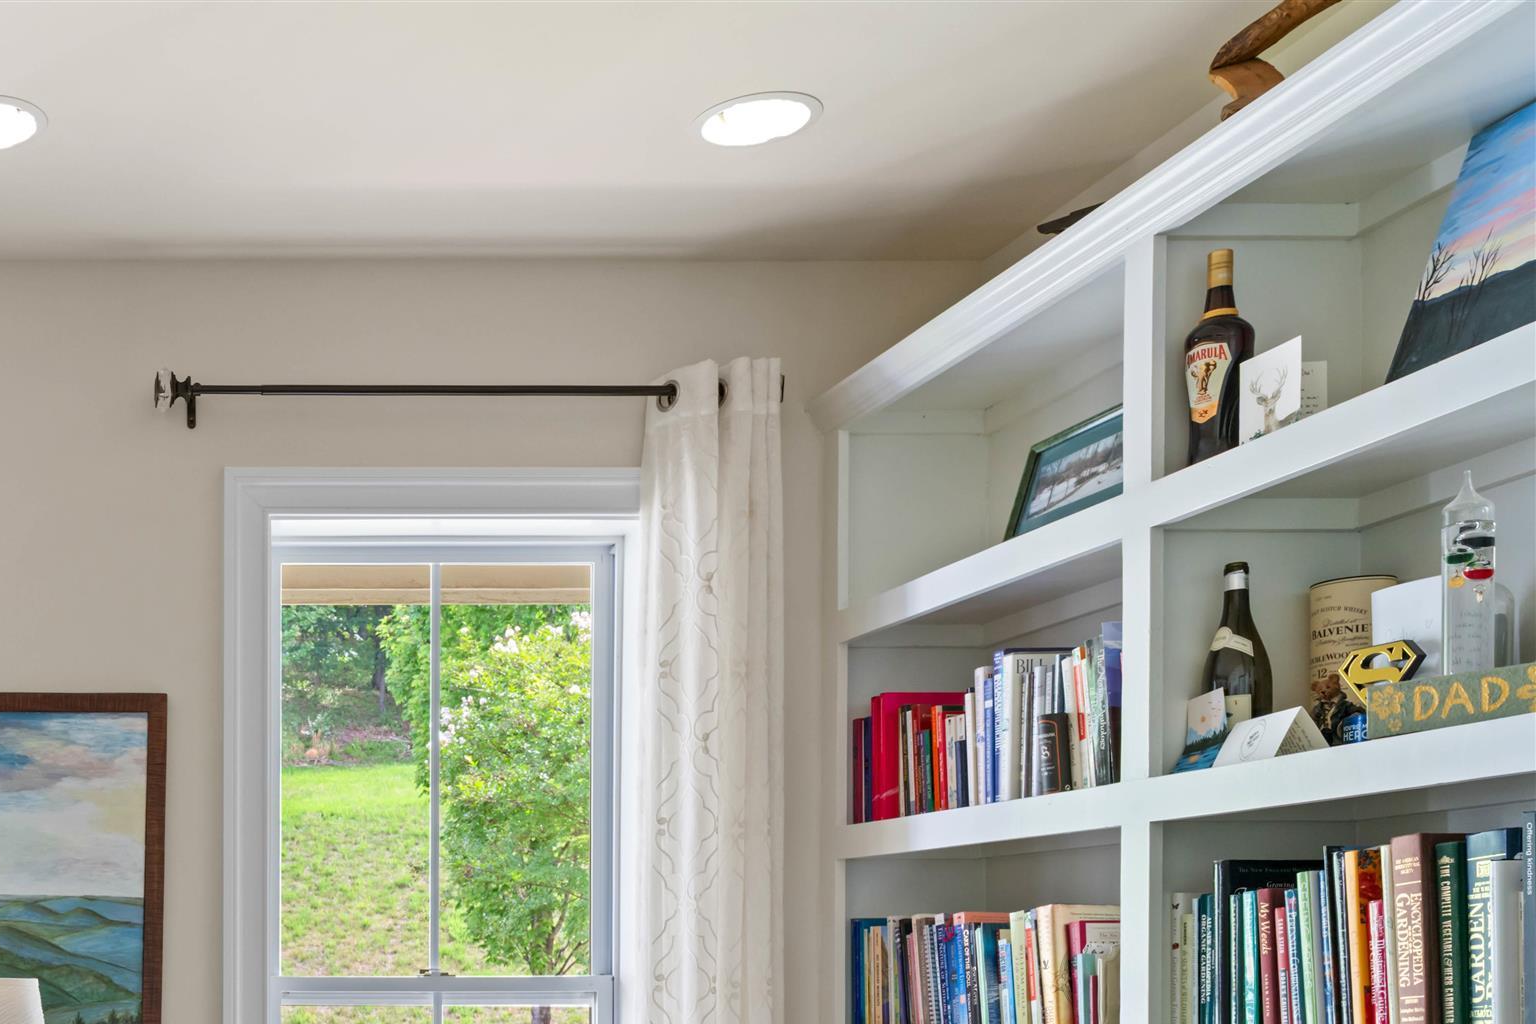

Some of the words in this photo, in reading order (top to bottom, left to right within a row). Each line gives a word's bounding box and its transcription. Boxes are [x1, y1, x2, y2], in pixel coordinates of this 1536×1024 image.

[1312, 624, 1368, 640] BALVENIE
[1317, 668, 1327, 679] 12
[1413, 676, 1510, 722] DAD
[1525, 822, 1533, 856] Offering
[1440, 864, 1450, 877] THE
[1526, 858, 1534, 895] kindness
[1260, 902, 1269, 919] My
[1441, 880, 1452, 917] COMPLETE
[965, 948, 969, 956] OF
[1261, 920, 1271, 955] Weeds
[1395, 893, 1410, 988] GARDENING
[1410, 893, 1424, 985] ENCYCLOPEDIA
[1442, 920, 1453, 957] VEGETABLE
[1468, 902, 1484, 1003] GARDEN
[1376, 938, 1387, 990] Illustrated
[1443, 958, 1453, 967] &
[1444, 967, 1454, 985] HERB
[1378, 991, 1388, 1021] Guide
[1444, 988, 1455, 1024] GARDENER
